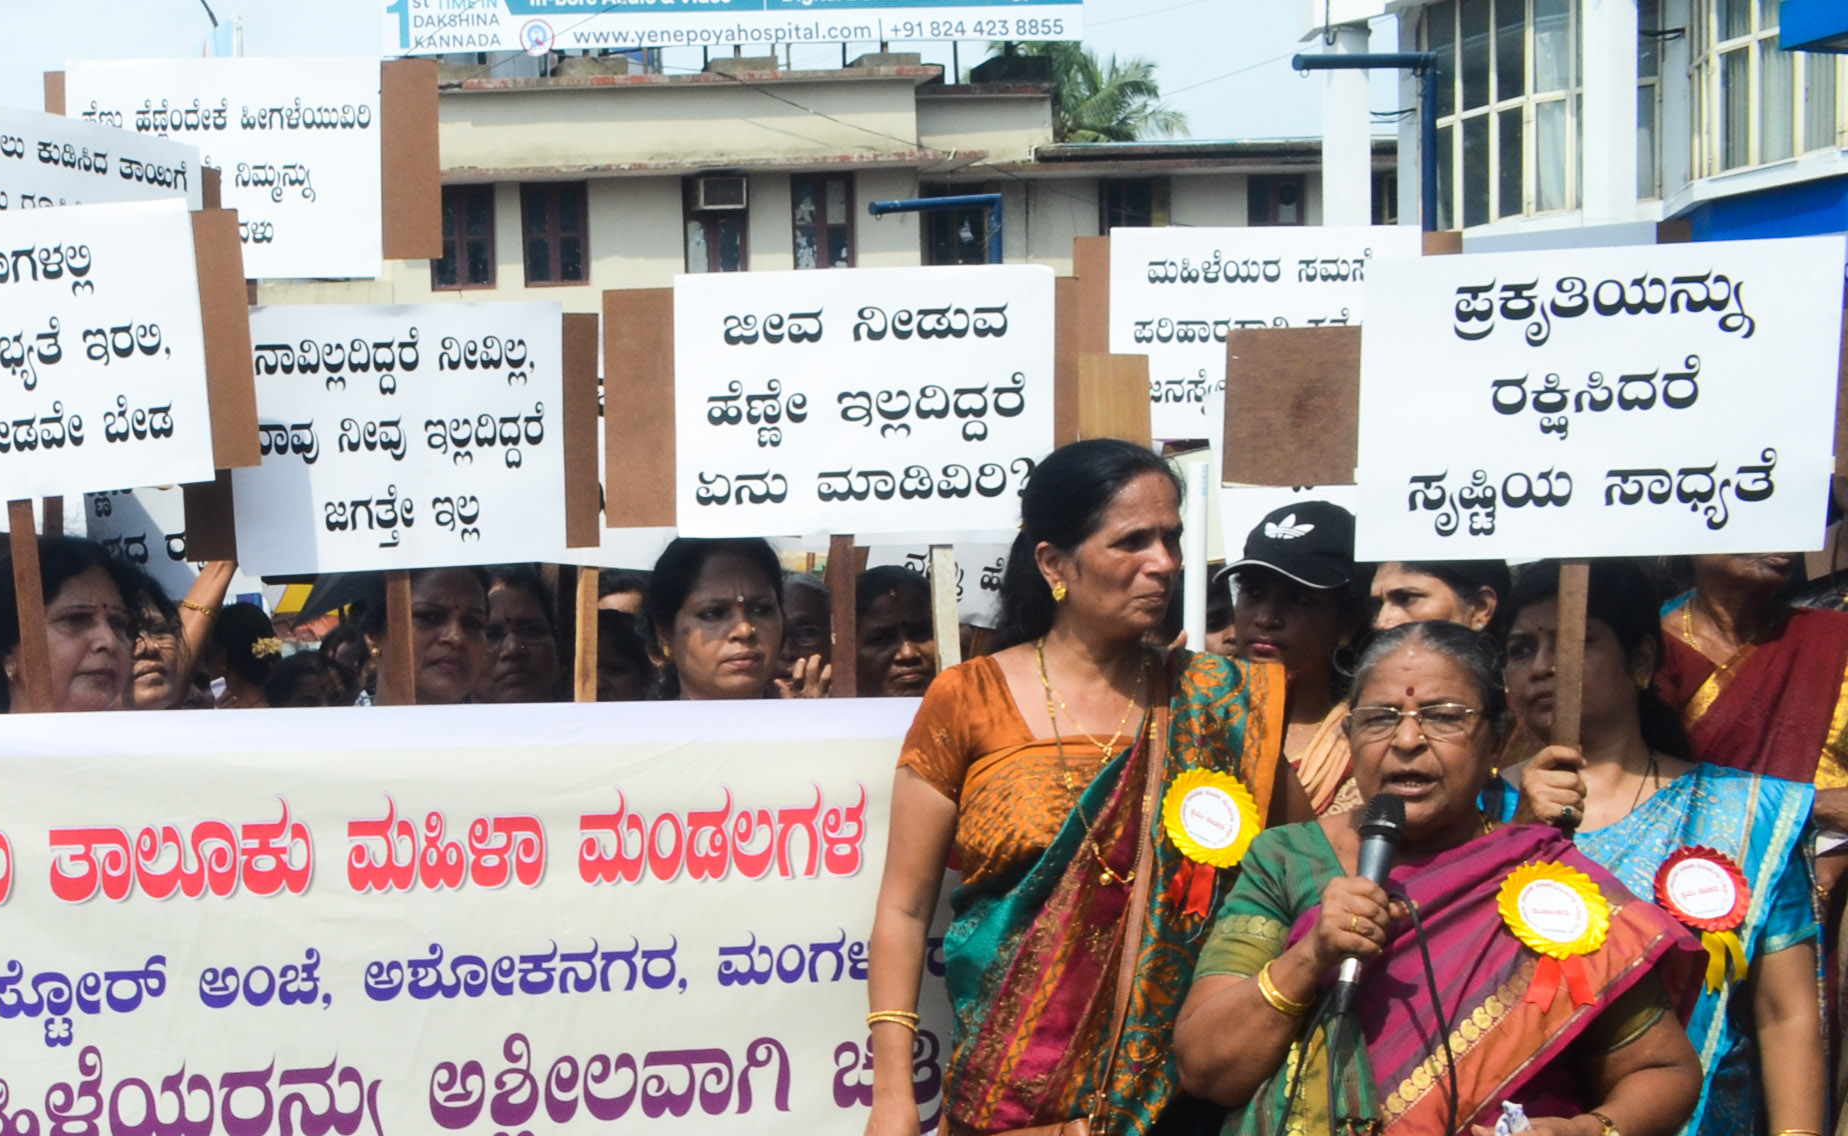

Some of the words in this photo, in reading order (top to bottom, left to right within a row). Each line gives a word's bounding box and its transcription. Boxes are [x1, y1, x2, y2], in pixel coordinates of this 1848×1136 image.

[414, 14, 500, 28] DAKSHINA
[414, 34, 500, 48] KANNADA
[574, 22, 872, 47] www.yenepoyahospital.com
[890, 22, 923, 38] +91
[930, 21, 965, 36] 824
[973, 20, 1009, 36] 423
[1016, 19, 1064, 35] 8855
[38, 140, 108, 175] ಕುಡಿಸಿದ
[119, 155, 188, 192] ತಾಯಿಗೆ
[235, 161, 316, 203] ನಿಮ್ಮನ್ನು
[1147, 249, 1281, 284] ಮಹಿಳೆಯರ
[722, 307, 824, 346] ಜೀವ
[852, 301, 1009, 342] ನೀಡುವ
[1454, 265, 1755, 347] ಪ್ರಕೃತಿಯನ್ನು
[81, 321, 171, 367] ಇರಲಿ,
[254, 326, 420, 395] ನಾವಿಲ್ಲದಿದ್ದರೆ
[438, 334, 535, 386] ನೀವಿಲ್ಲ,
[103, 394, 174, 444] ಬೇಡ
[707, 378, 807, 448] ಹೆಣ್ಣೇ
[836, 371, 1026, 442] ಇಲ್ಲದಿದ್ದರೆ
[1491, 354, 1701, 441] ರಕ್ಷಿಸಿದರೆ
[338, 415, 407, 461] ನೀವು
[424, 401, 545, 468] ಇಲ್ಲದಿದ್ದರೆ
[695, 465, 788, 506] ಏನು
[1408, 465, 1572, 537] ಸೃಷ್ಟಿಯ
[1604, 447, 1777, 530] ಸಾಧ್ಯತೆ
[324, 484, 414, 548] ಜಗತ್ತೇ
[432, 494, 481, 542] ಇಲ್ಲ
[49, 793, 313, 903] ತಾಲೂಕು
[347, 791, 545, 896] ಮಹಿಳಾ
[577, 780, 867, 888] ಮಂಡಲಗಳ
[199, 945, 332, 1011] ಅಂಚೆ,
[364, 932, 687, 1002] ಅಶೋಕನಗರ,
